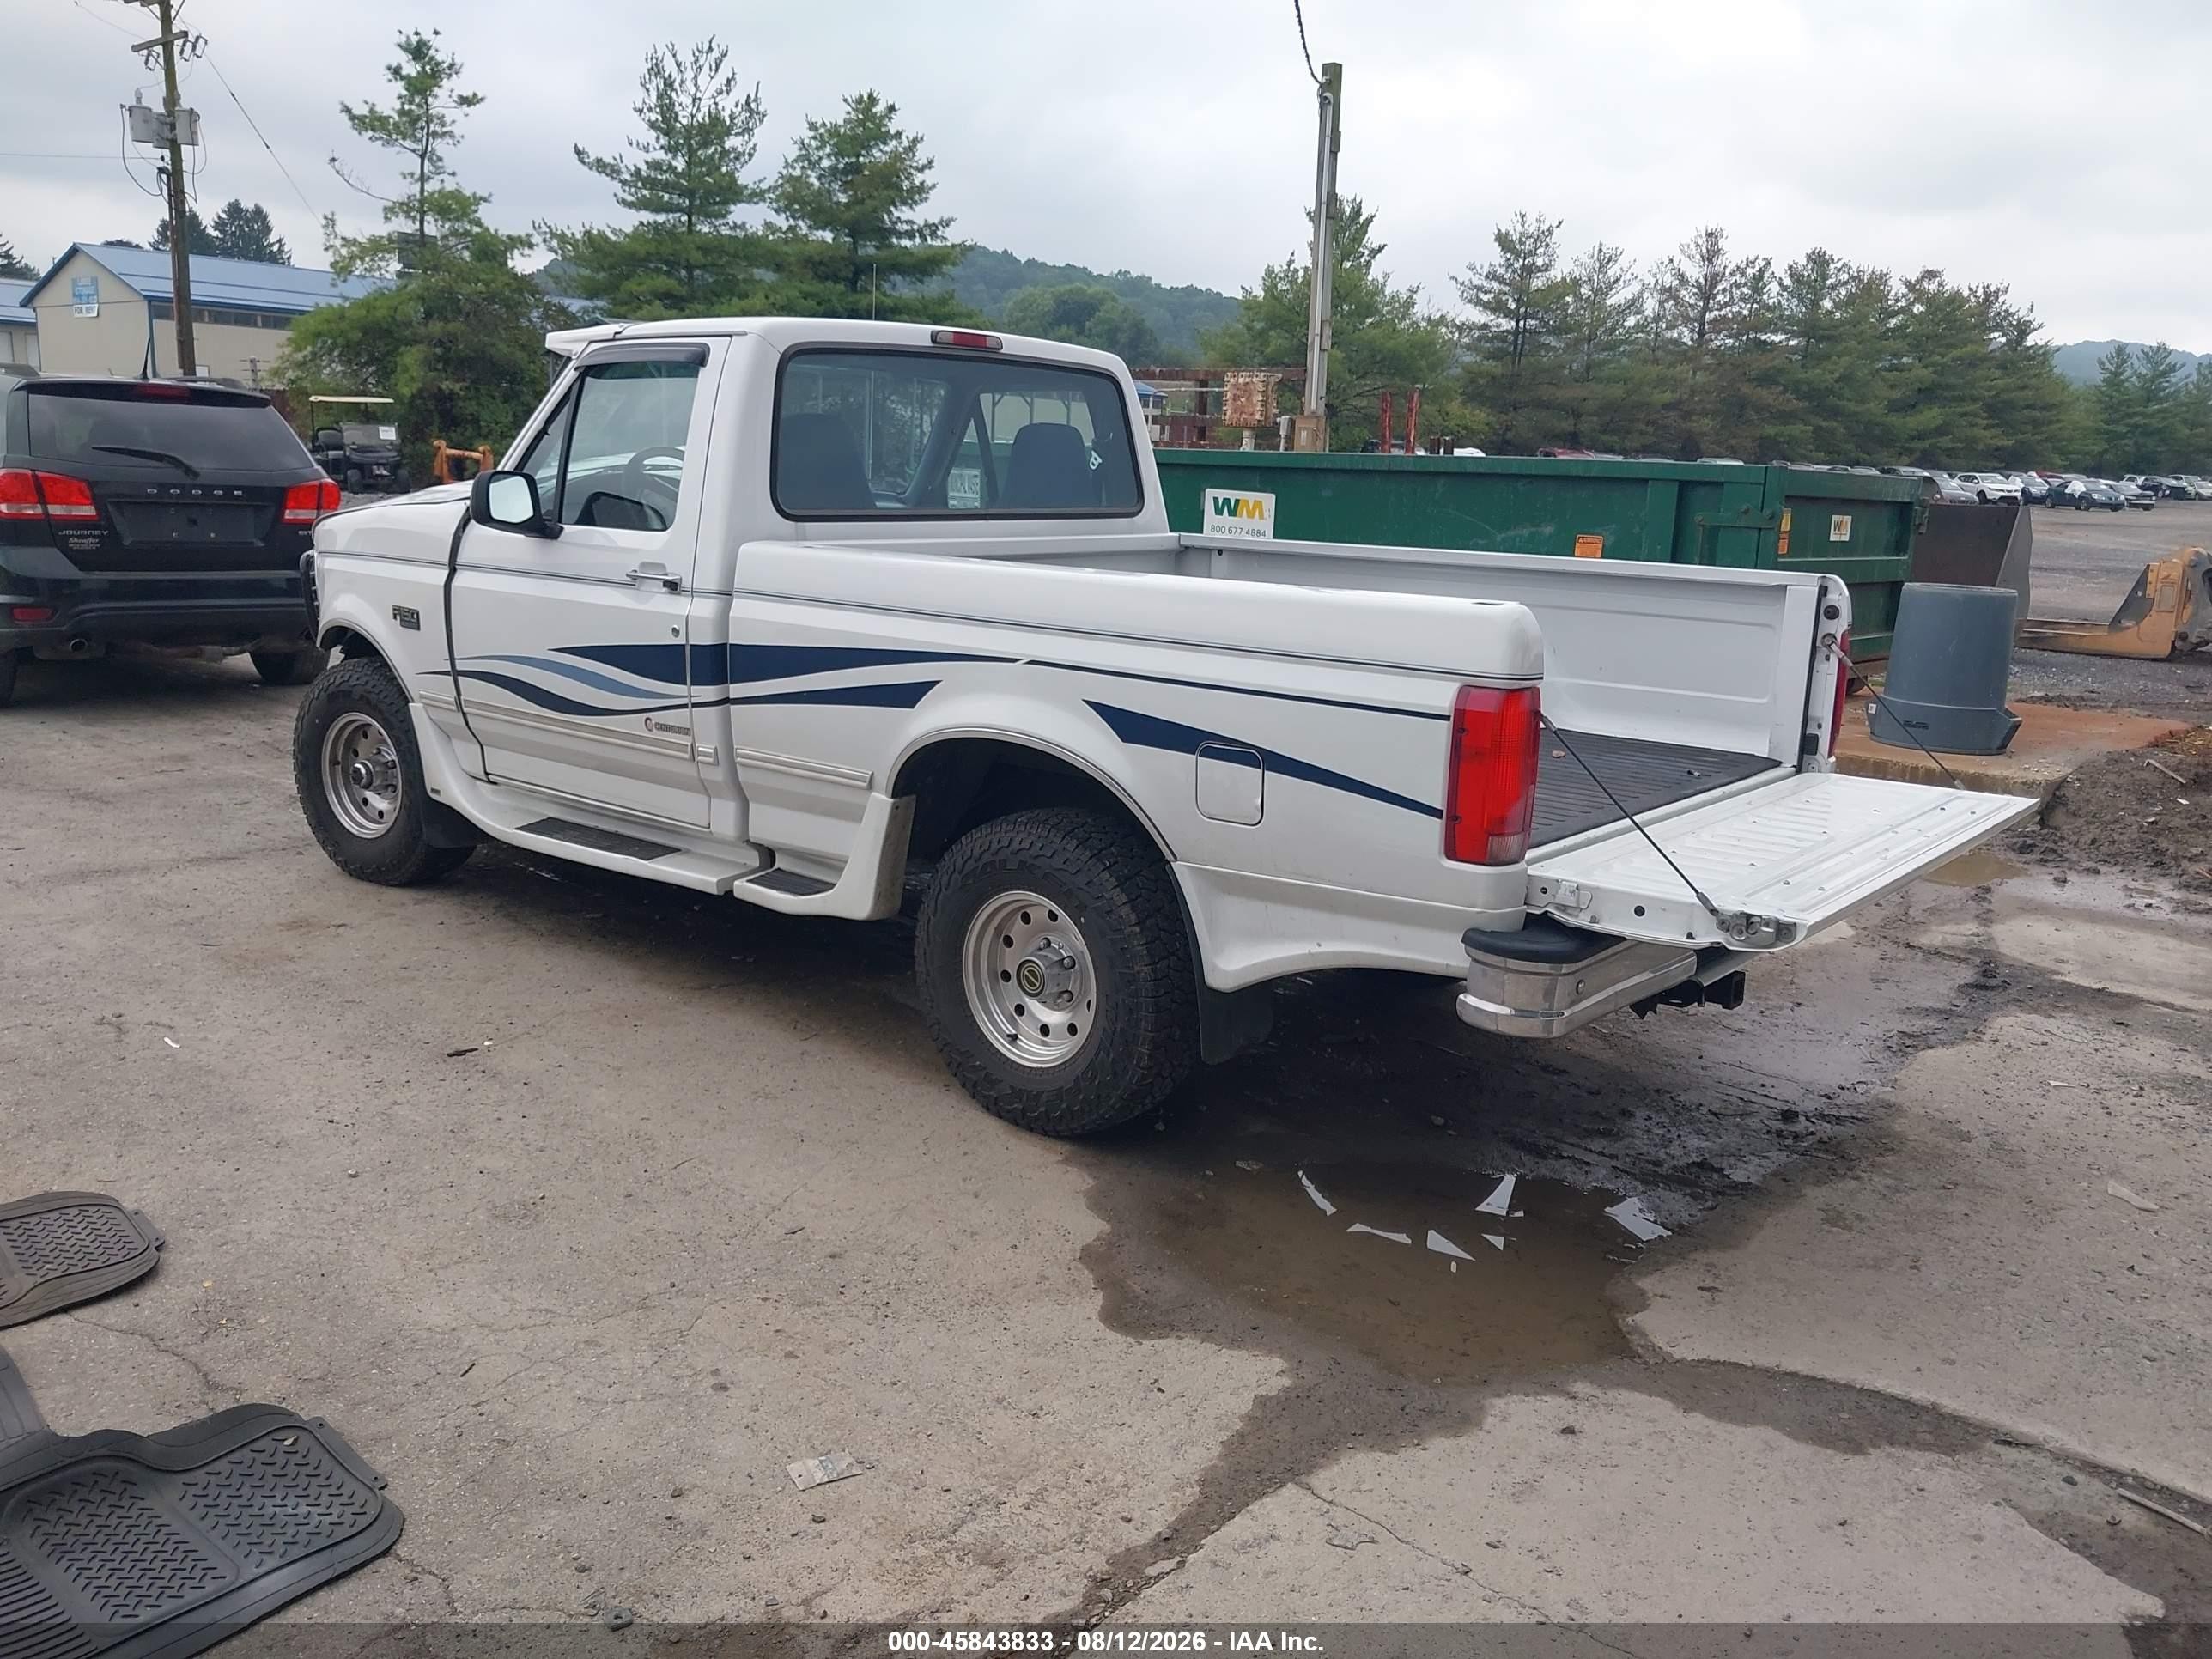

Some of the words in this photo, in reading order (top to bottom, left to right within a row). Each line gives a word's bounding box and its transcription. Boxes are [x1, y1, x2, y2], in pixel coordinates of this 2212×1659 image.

[1212, 496, 1265, 520] WM
[1210, 525, 1226, 534] 800
[1228, 526, 1243, 536] 677
[1245, 529, 1267, 538] 4884
